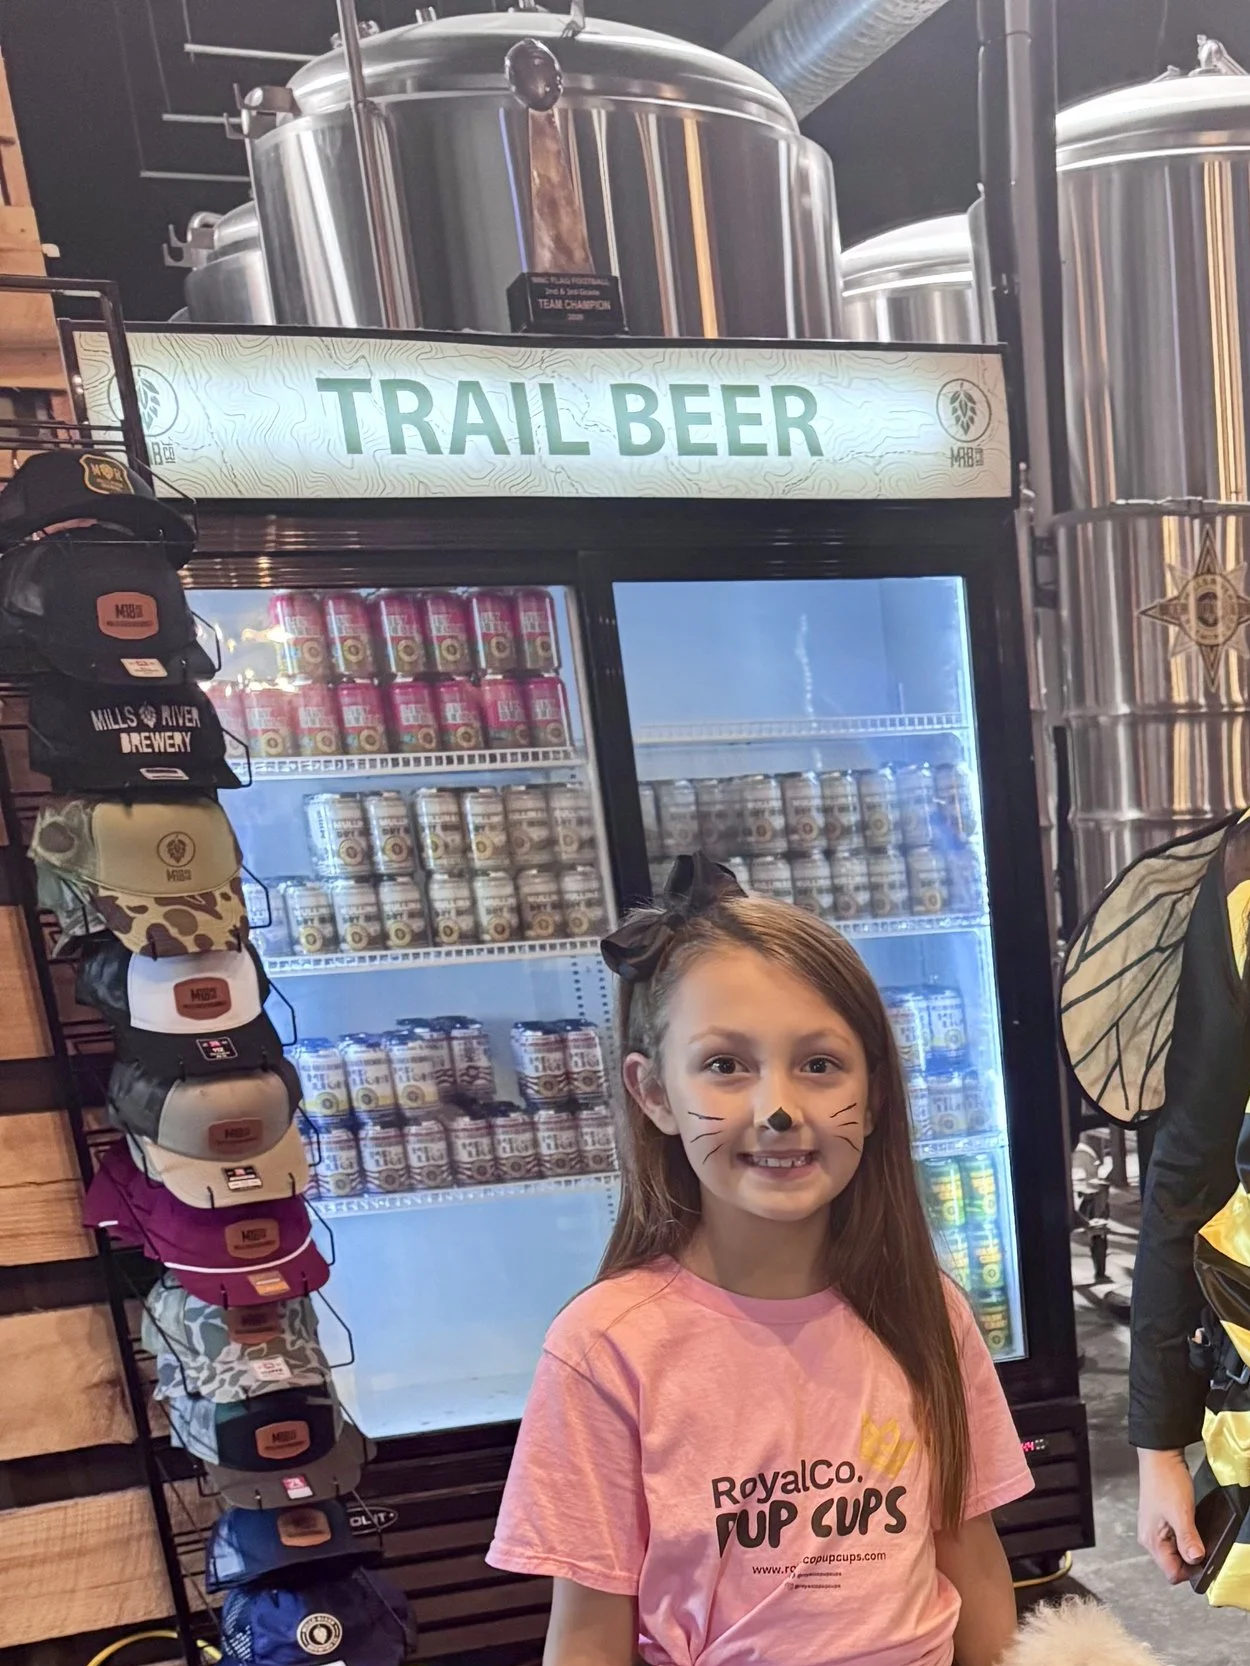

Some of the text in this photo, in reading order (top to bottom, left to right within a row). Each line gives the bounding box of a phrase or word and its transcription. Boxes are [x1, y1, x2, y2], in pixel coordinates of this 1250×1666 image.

[538, 299, 611, 311] TEAM CHAMPION
[315, 377, 825, 457] TRAIL BEER
[90, 705, 201, 731] MILLS RIVER
[120, 732, 191, 753] BREWERY
[712, 1459, 863, 1508] RoyalCo.
[716, 1486, 907, 1559] PUP CUPS
